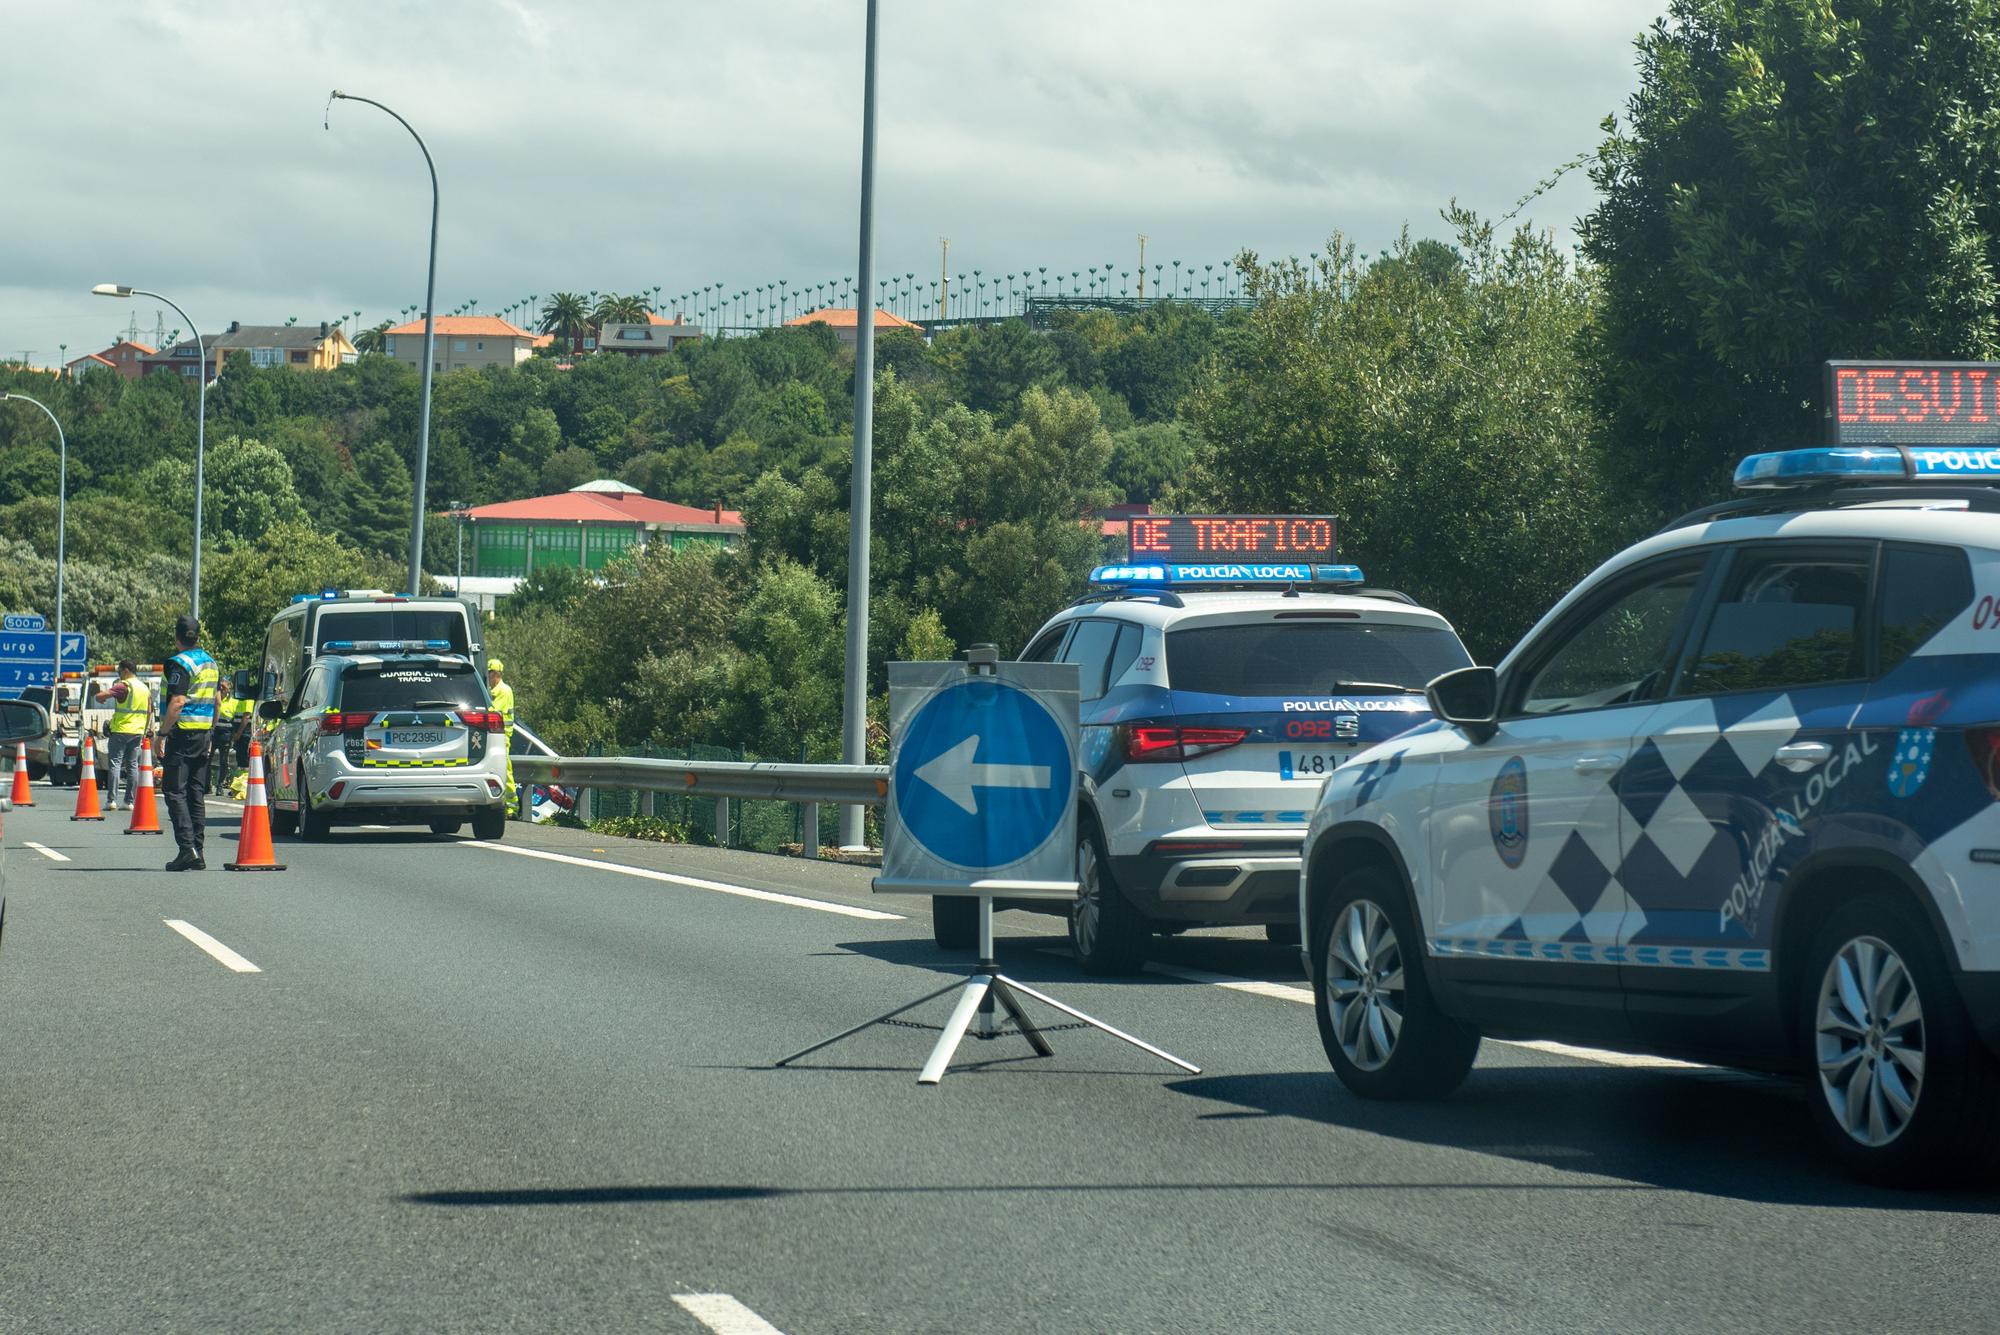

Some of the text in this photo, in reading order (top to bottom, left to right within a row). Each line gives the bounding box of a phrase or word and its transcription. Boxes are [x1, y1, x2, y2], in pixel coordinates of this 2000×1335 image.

[1837, 370, 2000, 423] DESVI
[1923, 448, 2000, 470] POLIC
[1132, 520, 1331, 550] DE TRAFICO
[1178, 564, 1304, 578] POLICÍA LOCAL
[7, 618, 30, 628] 500
[2, 643, 35, 654] urgo
[14, 670, 21, 681] 7
[28, 672, 35, 681] a
[380, 670, 422, 678] GUARDIA
[1283, 699, 1346, 712] POLICÍA
[1286, 720, 1332, 737] 092
[392, 732, 443, 743] PGC2395U
[1793, 731, 1879, 819] LOCAL
